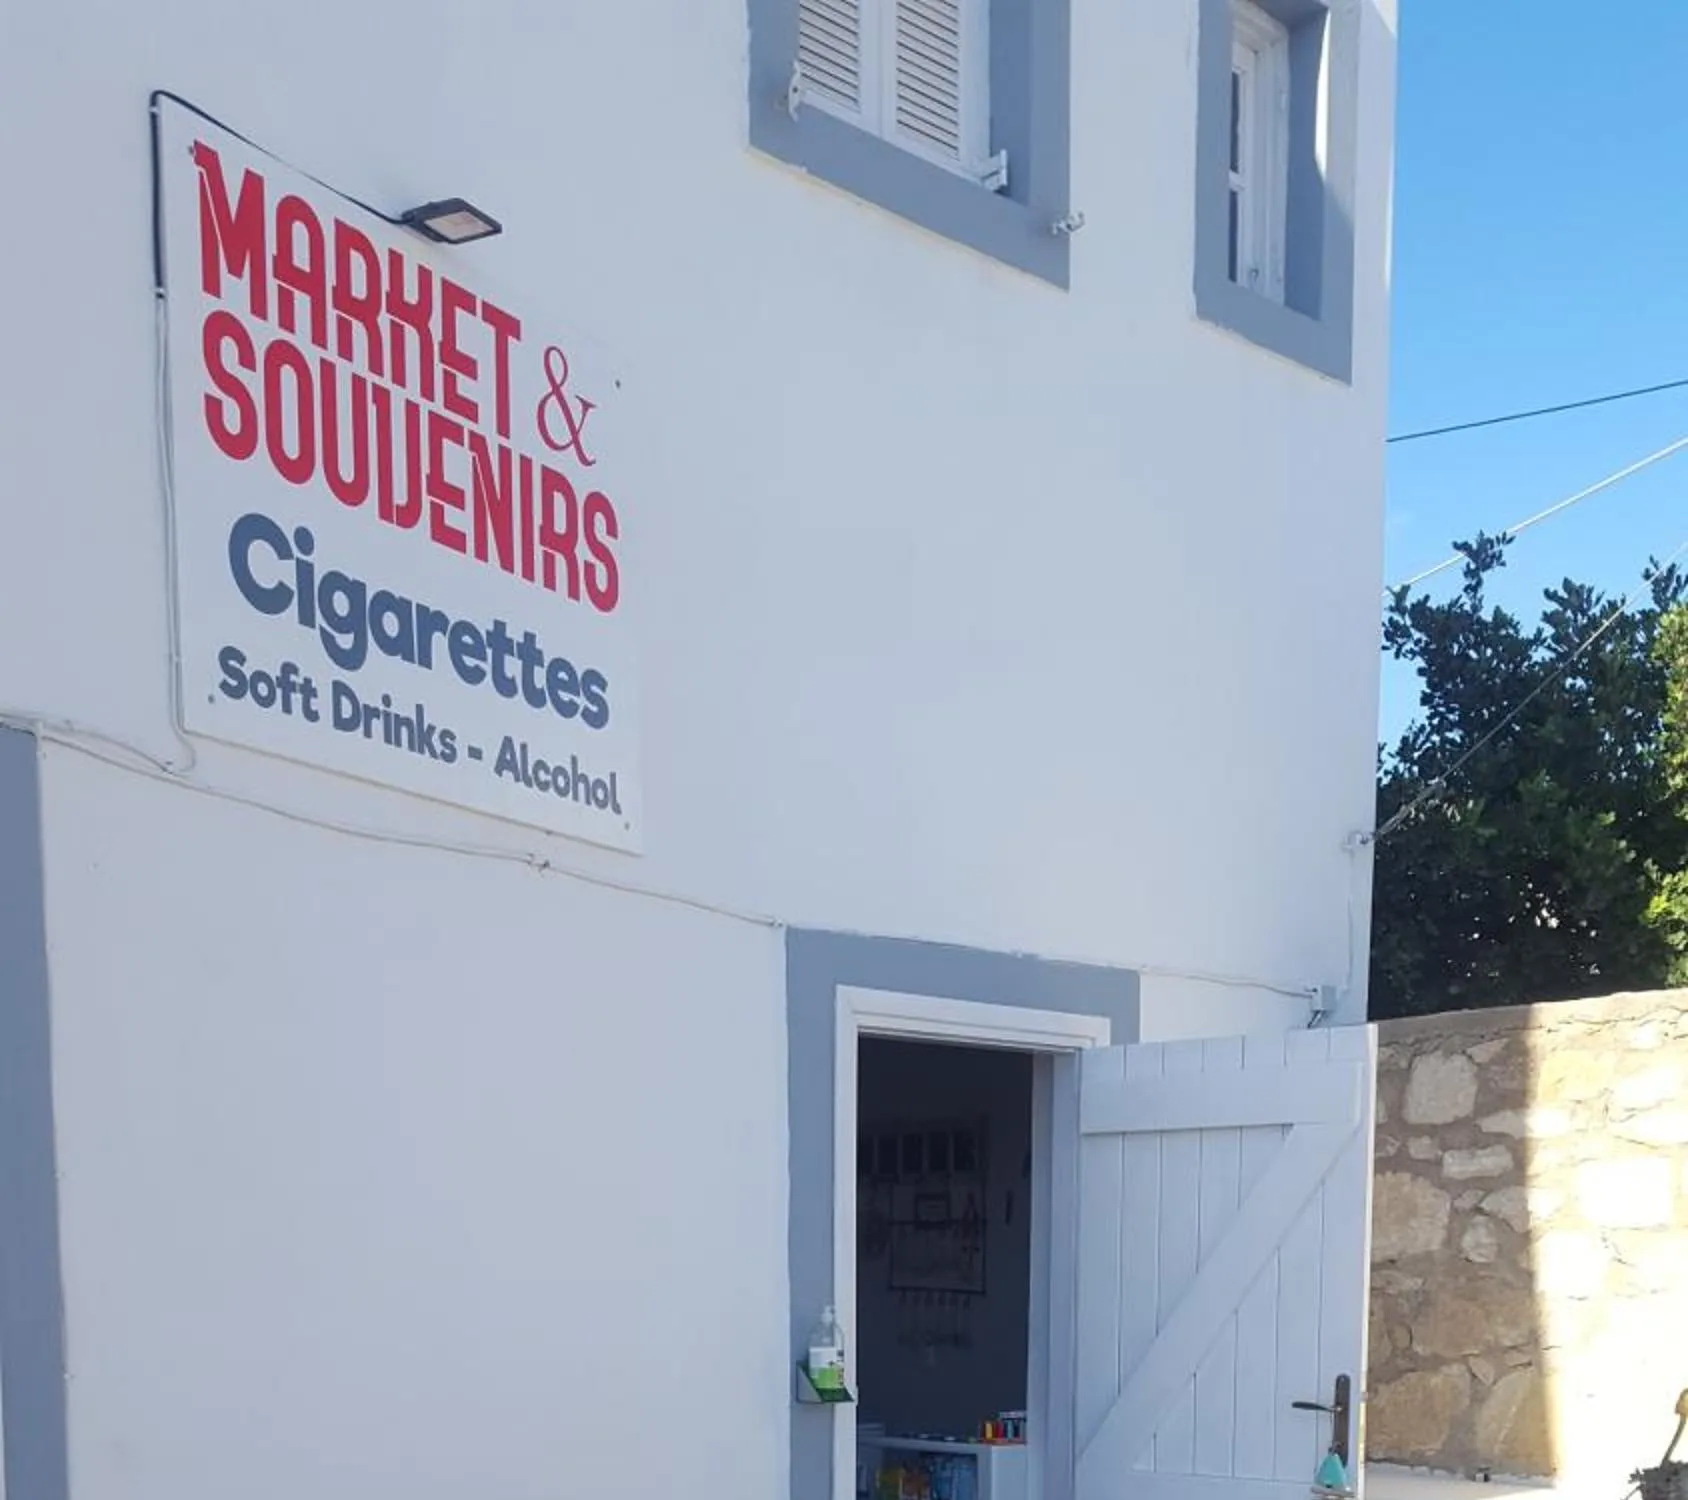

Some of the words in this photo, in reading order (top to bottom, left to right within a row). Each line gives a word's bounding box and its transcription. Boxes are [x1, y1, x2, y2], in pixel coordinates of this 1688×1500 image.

[192, 140, 522, 442] MARKET
[536, 345, 598, 467] &
[202, 310, 620, 613] SOUVENIRS
[218, 645, 320, 723] Soft
[331, 679, 457, 763] Drinks
[494, 735, 622, 815] Alcohol
[228, 513, 609, 729] Cigarettes
